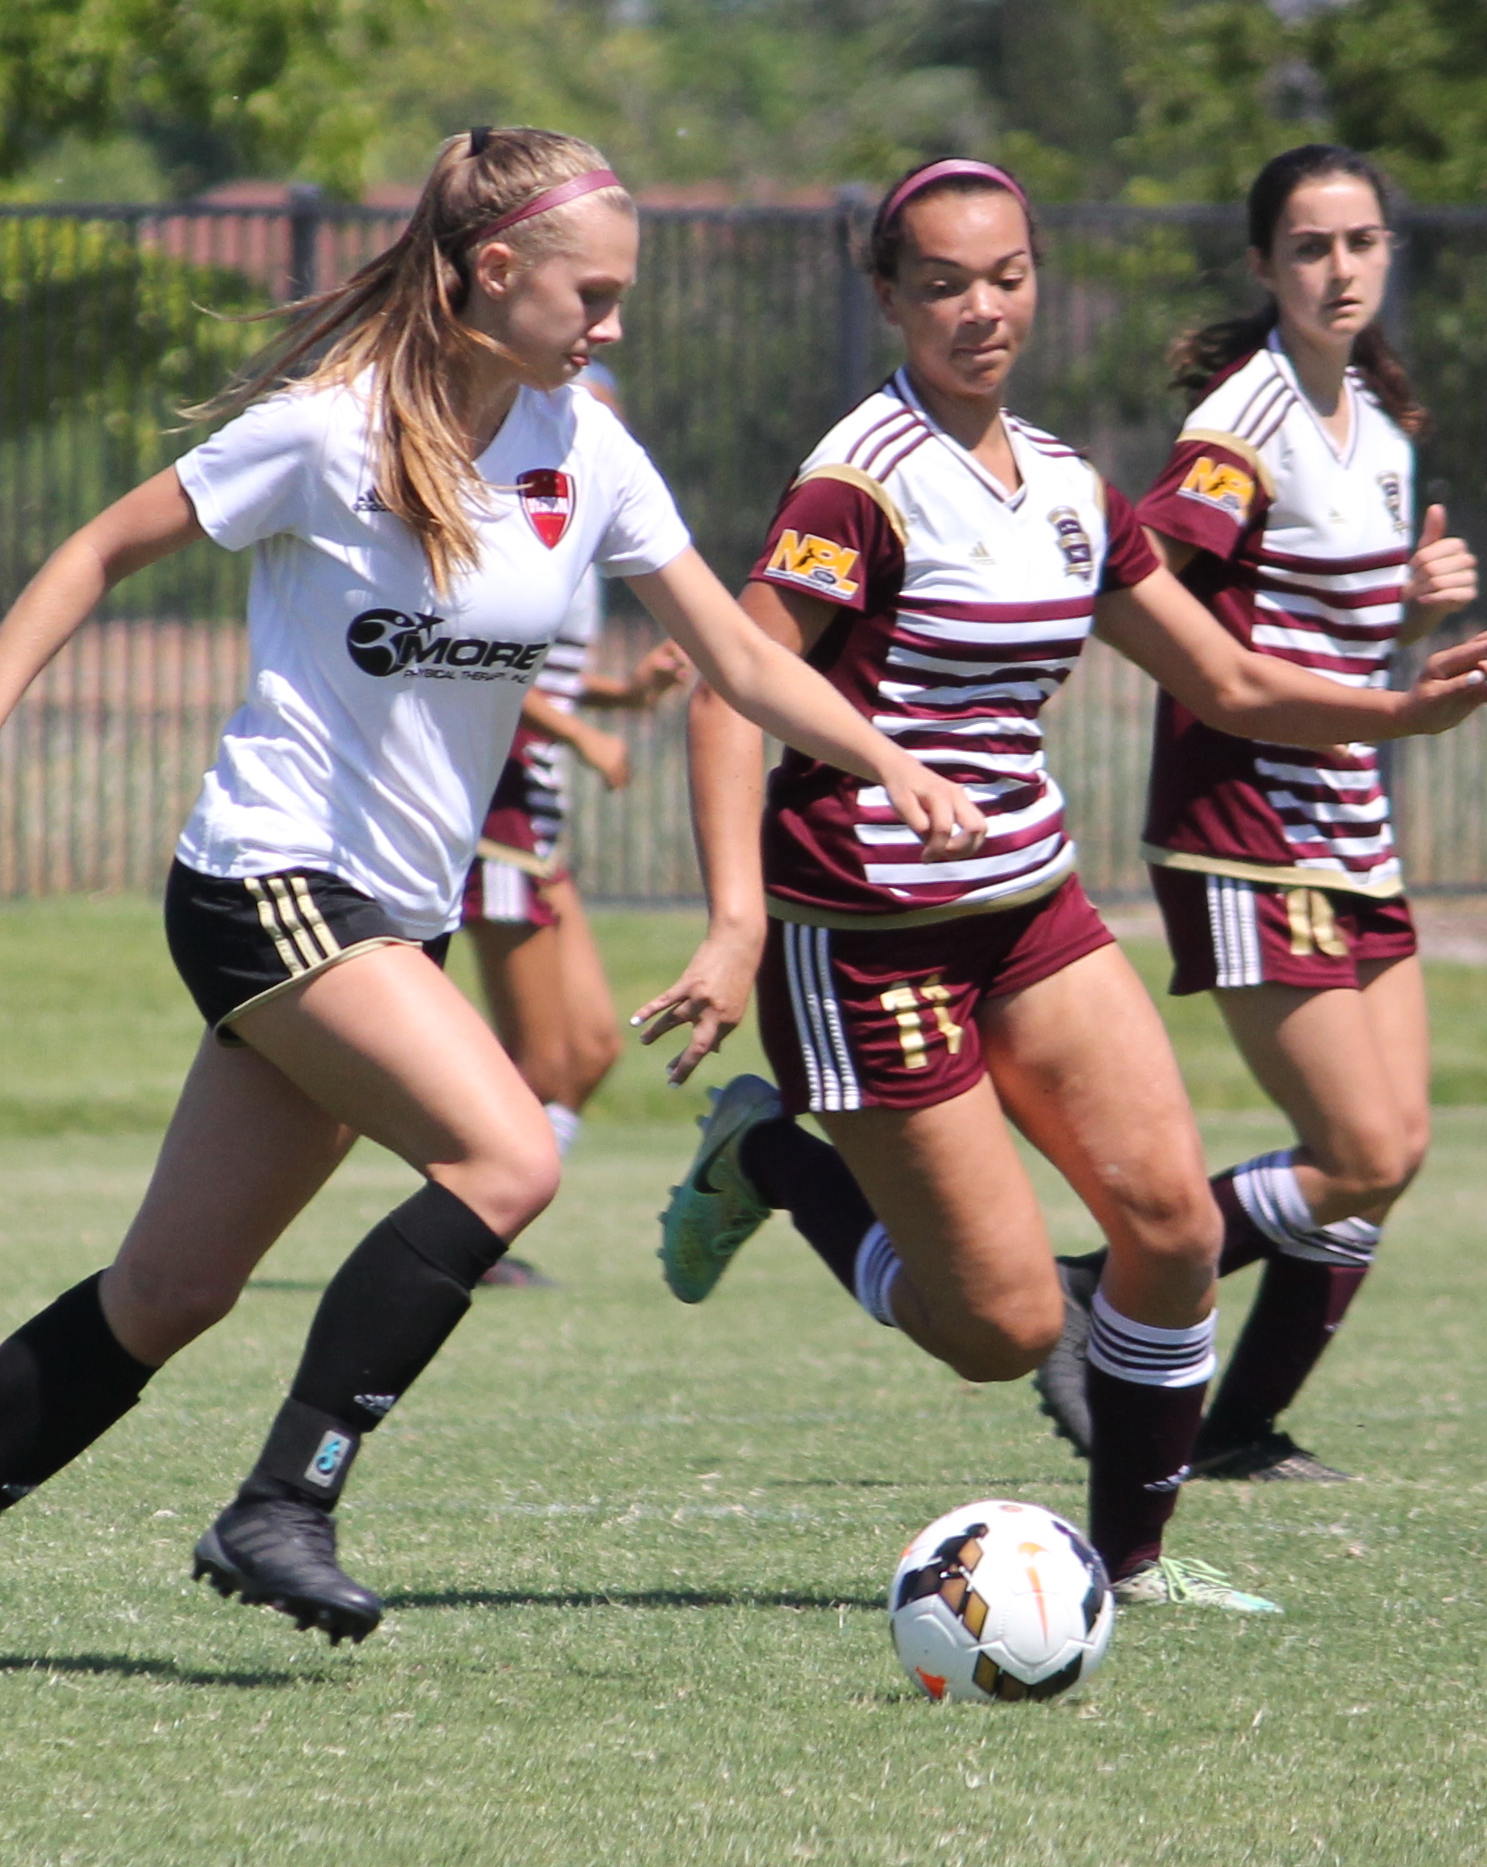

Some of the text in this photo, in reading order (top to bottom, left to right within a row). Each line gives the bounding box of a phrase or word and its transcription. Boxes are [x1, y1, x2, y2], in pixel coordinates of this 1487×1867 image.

[765, 528, 861, 593] NPL
[399, 634, 548, 670] MORE
[880, 975, 963, 1069] 11
